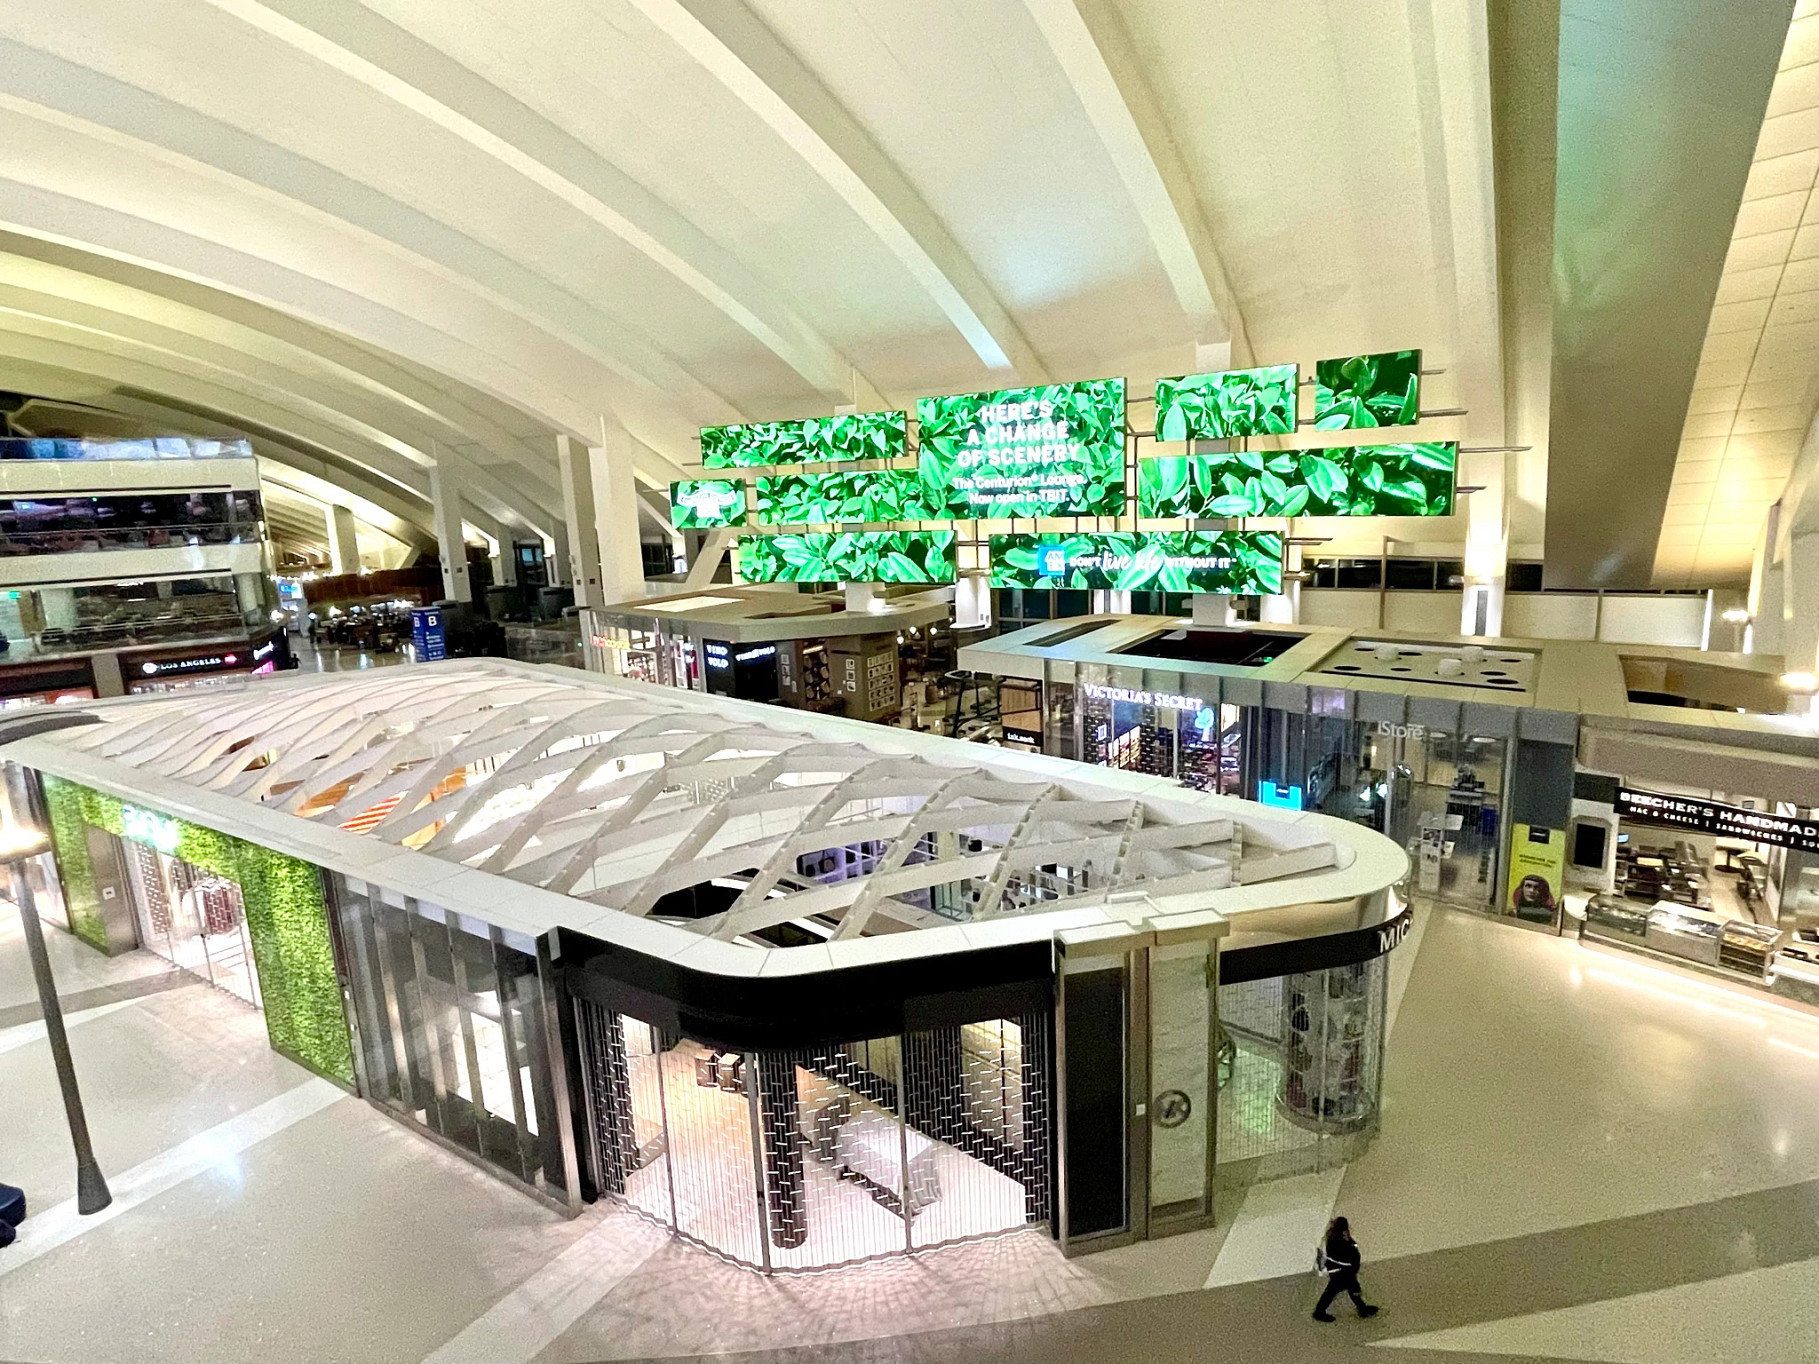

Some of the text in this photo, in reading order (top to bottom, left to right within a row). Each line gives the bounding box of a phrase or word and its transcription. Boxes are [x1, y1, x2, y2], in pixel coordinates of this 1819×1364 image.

[981, 400, 1053, 422] HERE'S
[966, 420, 1070, 446] A CHANGE
[957, 443, 1081, 468] OF SCENERY
[953, 477, 974, 489] The
[1040, 473, 1088, 487] Lounge.
[968, 488, 1070, 506] Now open in TBIT.
[1069, 556, 1100, 568] DON'T
[1102, 550, 1131, 571] live
[1164, 556, 1216, 569] WITHOUT
[428, 615, 438, 627] B
[160, 661, 178, 670] LOS
[180, 656, 222, 668] ANGELES
[1083, 683, 1203, 711] VICTORIA'S SECRET
[1619, 791, 1819, 838] BEECHER'S HANDMAD
[1629, 806, 1649, 815] MAC
[1663, 812, 1700, 826] CHEESE
[1715, 822, 1784, 843] SANDWICHES
[1377, 918, 1413, 954] MIC
